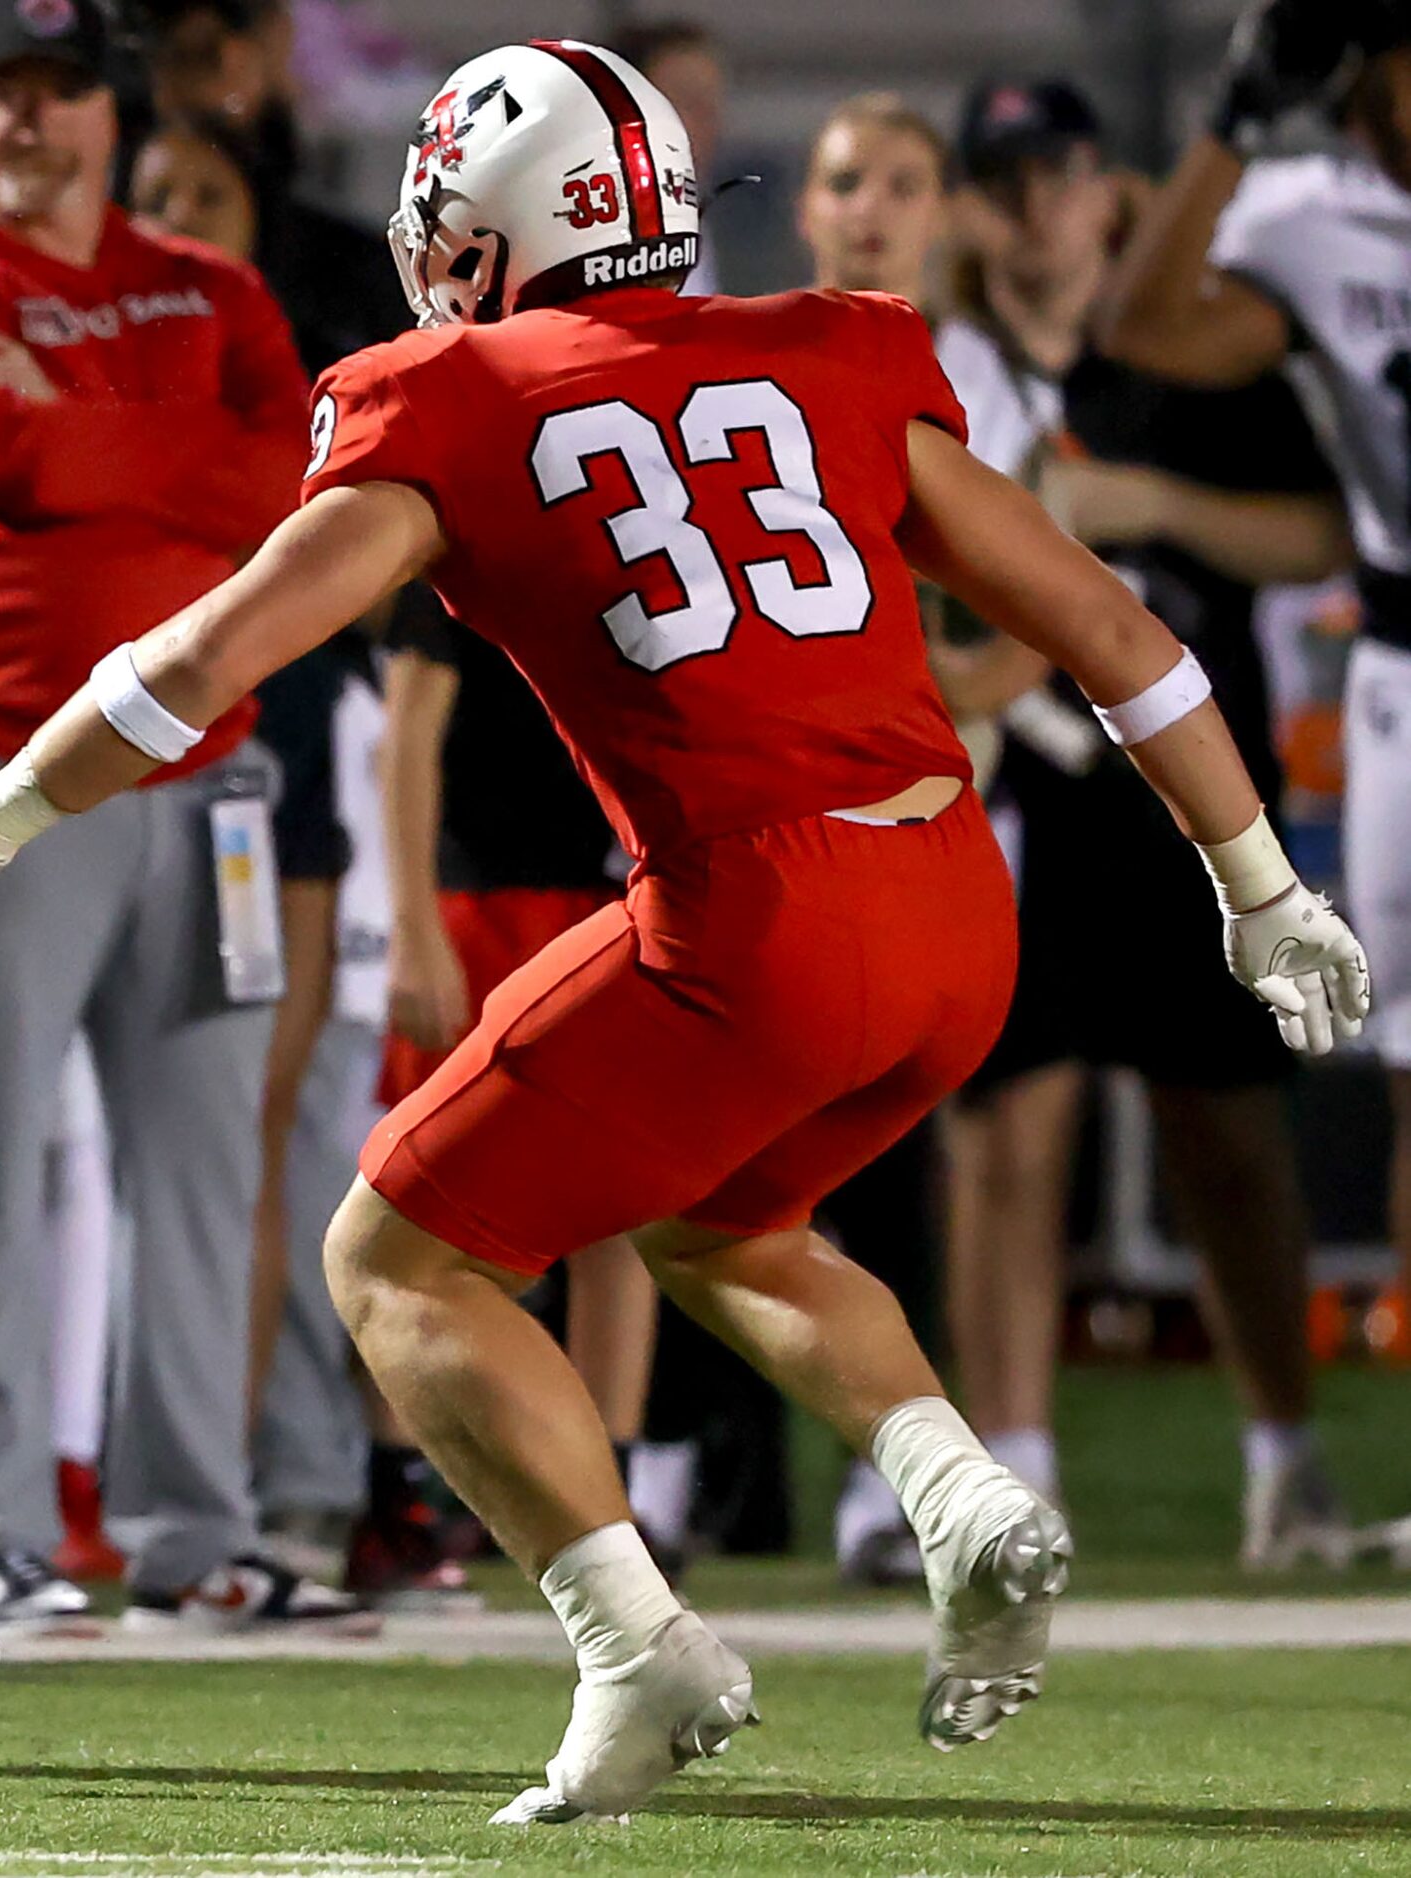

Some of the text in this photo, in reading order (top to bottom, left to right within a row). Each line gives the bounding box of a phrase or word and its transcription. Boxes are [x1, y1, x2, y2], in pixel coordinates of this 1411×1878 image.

[562, 173, 620, 230] 33
[583, 236, 697, 286] Riddell
[528, 378, 874, 672] 33
